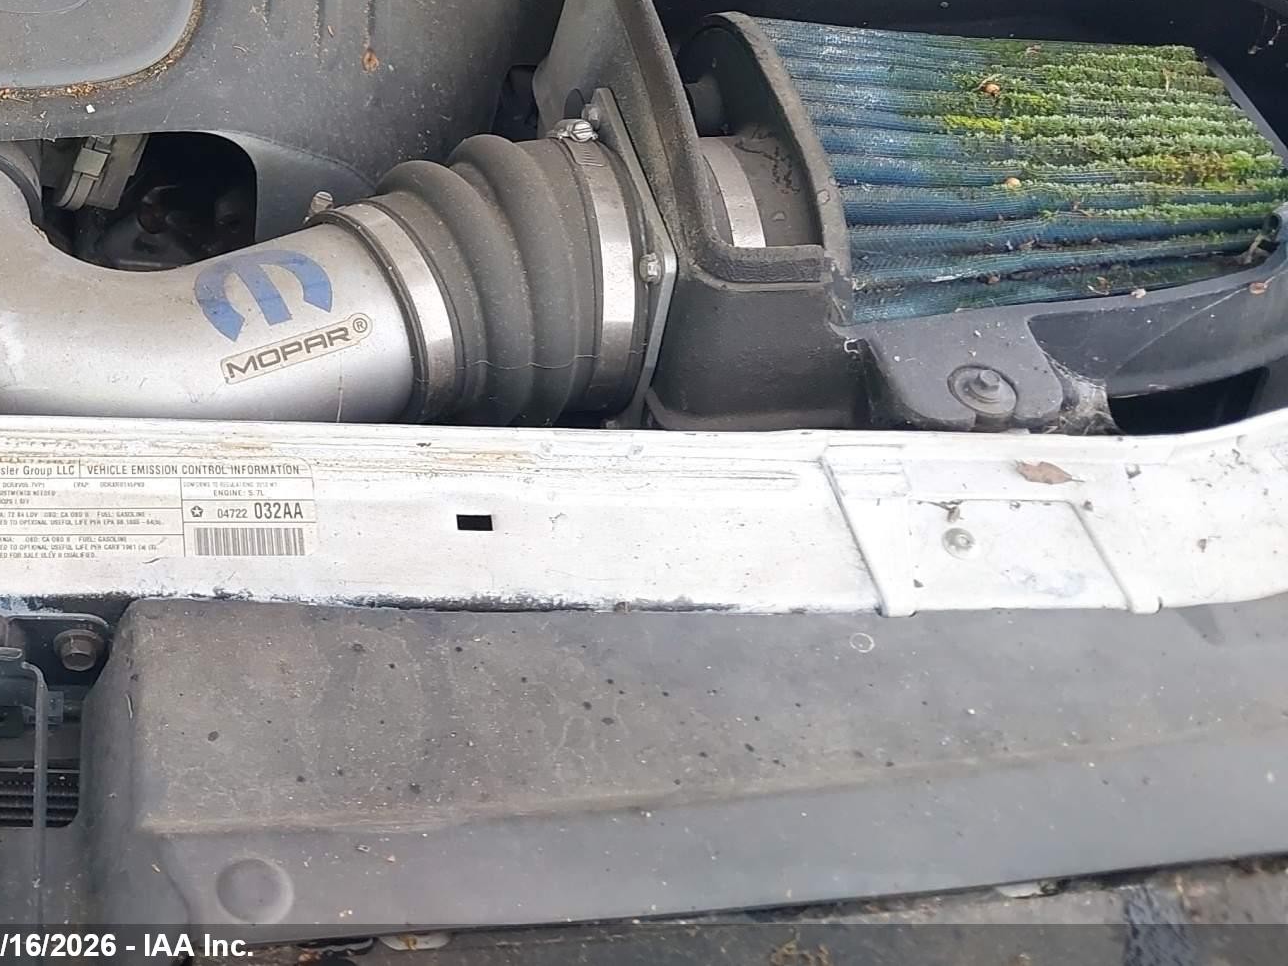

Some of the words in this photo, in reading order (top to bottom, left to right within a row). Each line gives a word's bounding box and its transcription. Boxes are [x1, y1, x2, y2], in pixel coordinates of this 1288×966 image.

[23, 465, 53, 476] Group
[56, 465, 75, 475] LLC
[87, 465, 127, 475] VEHICLE
[132, 465, 177, 475] EMISSION
[181, 464, 228, 475] CONTROL
[231, 464, 300, 475] INFORMATION
[217, 508, 248, 519] 04722
[254, 502, 304, 519] 032AA
